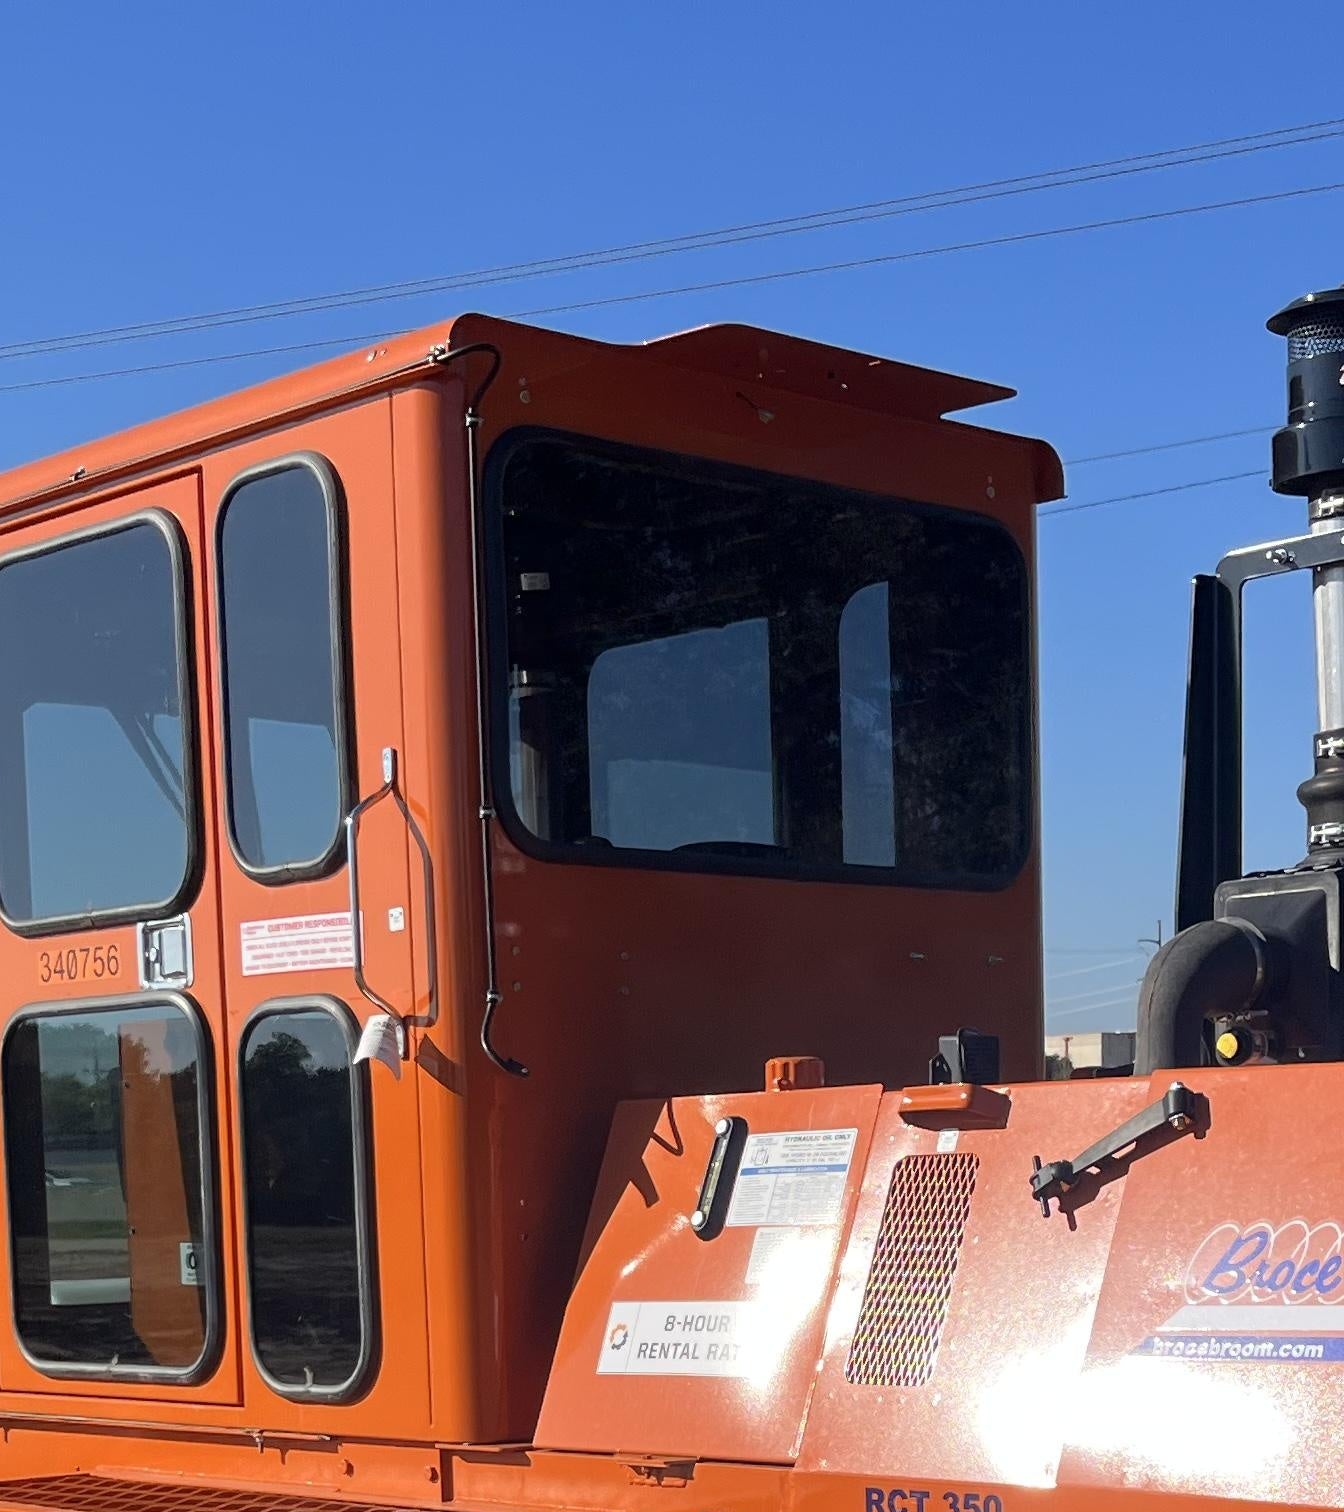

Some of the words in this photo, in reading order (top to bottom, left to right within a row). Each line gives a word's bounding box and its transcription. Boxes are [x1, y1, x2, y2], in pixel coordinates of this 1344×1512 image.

[268, 921, 304, 933] CUSTOMER
[305, 917, 353, 929] RESPONSIBIL
[39, 944, 120, 982] 340756
[1202, 1230, 1342, 1298] Broce
[664, 1314, 730, 1332] 8-HOUR
[637, 1342, 699, 1360] RENTAL
[706, 1343, 742, 1361] RAT
[1152, 1336, 1324, 1358] brocebroom.com
